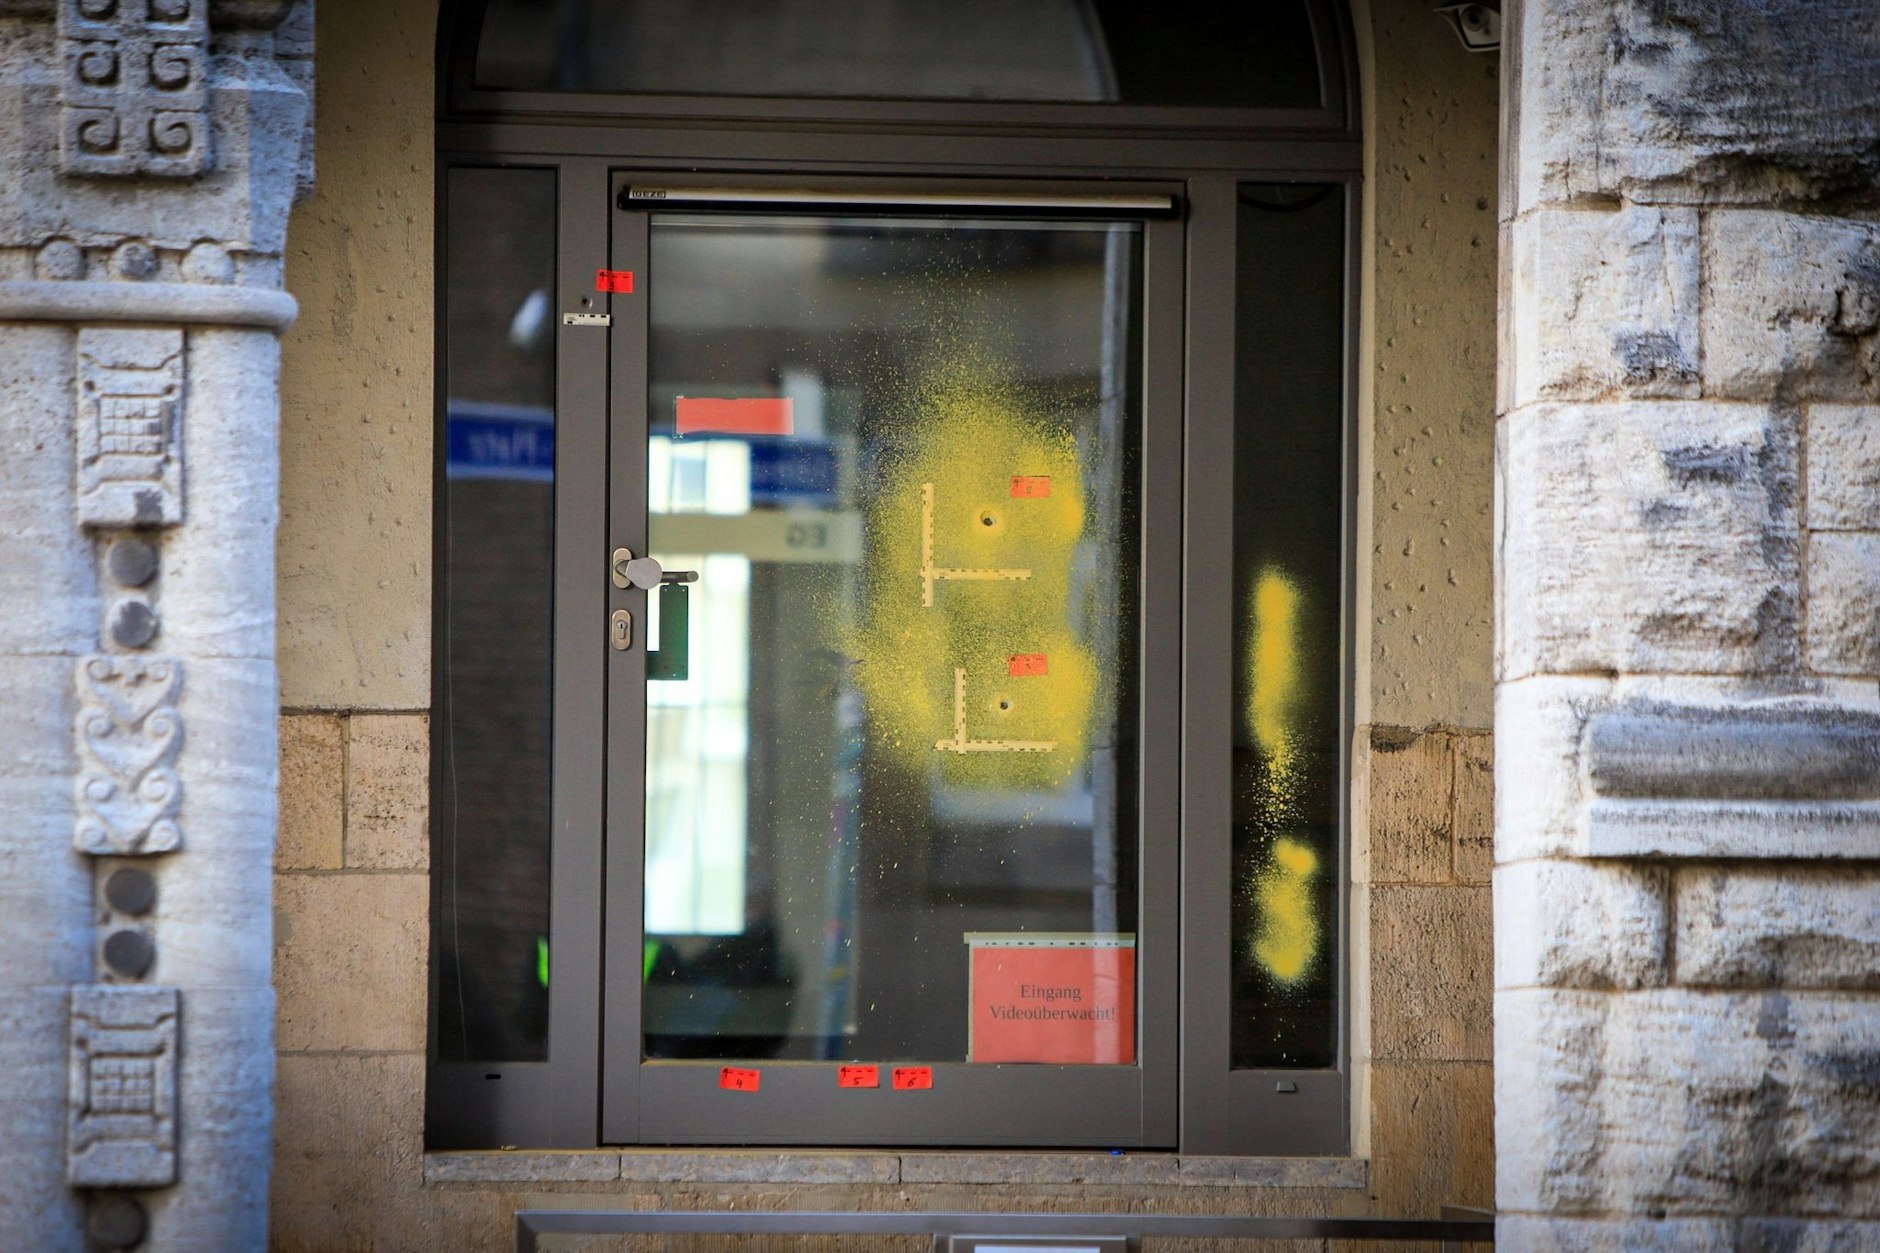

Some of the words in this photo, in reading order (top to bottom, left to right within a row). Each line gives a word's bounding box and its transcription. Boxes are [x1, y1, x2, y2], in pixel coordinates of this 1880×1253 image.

[1020, 984, 1082, 1002] Eingang
[989, 1005, 1116, 1021] Videoüberwacht!
[736, 1079, 743, 1089] 4
[853, 1076, 863, 1086] 5
[907, 1077, 917, 1087] 6
